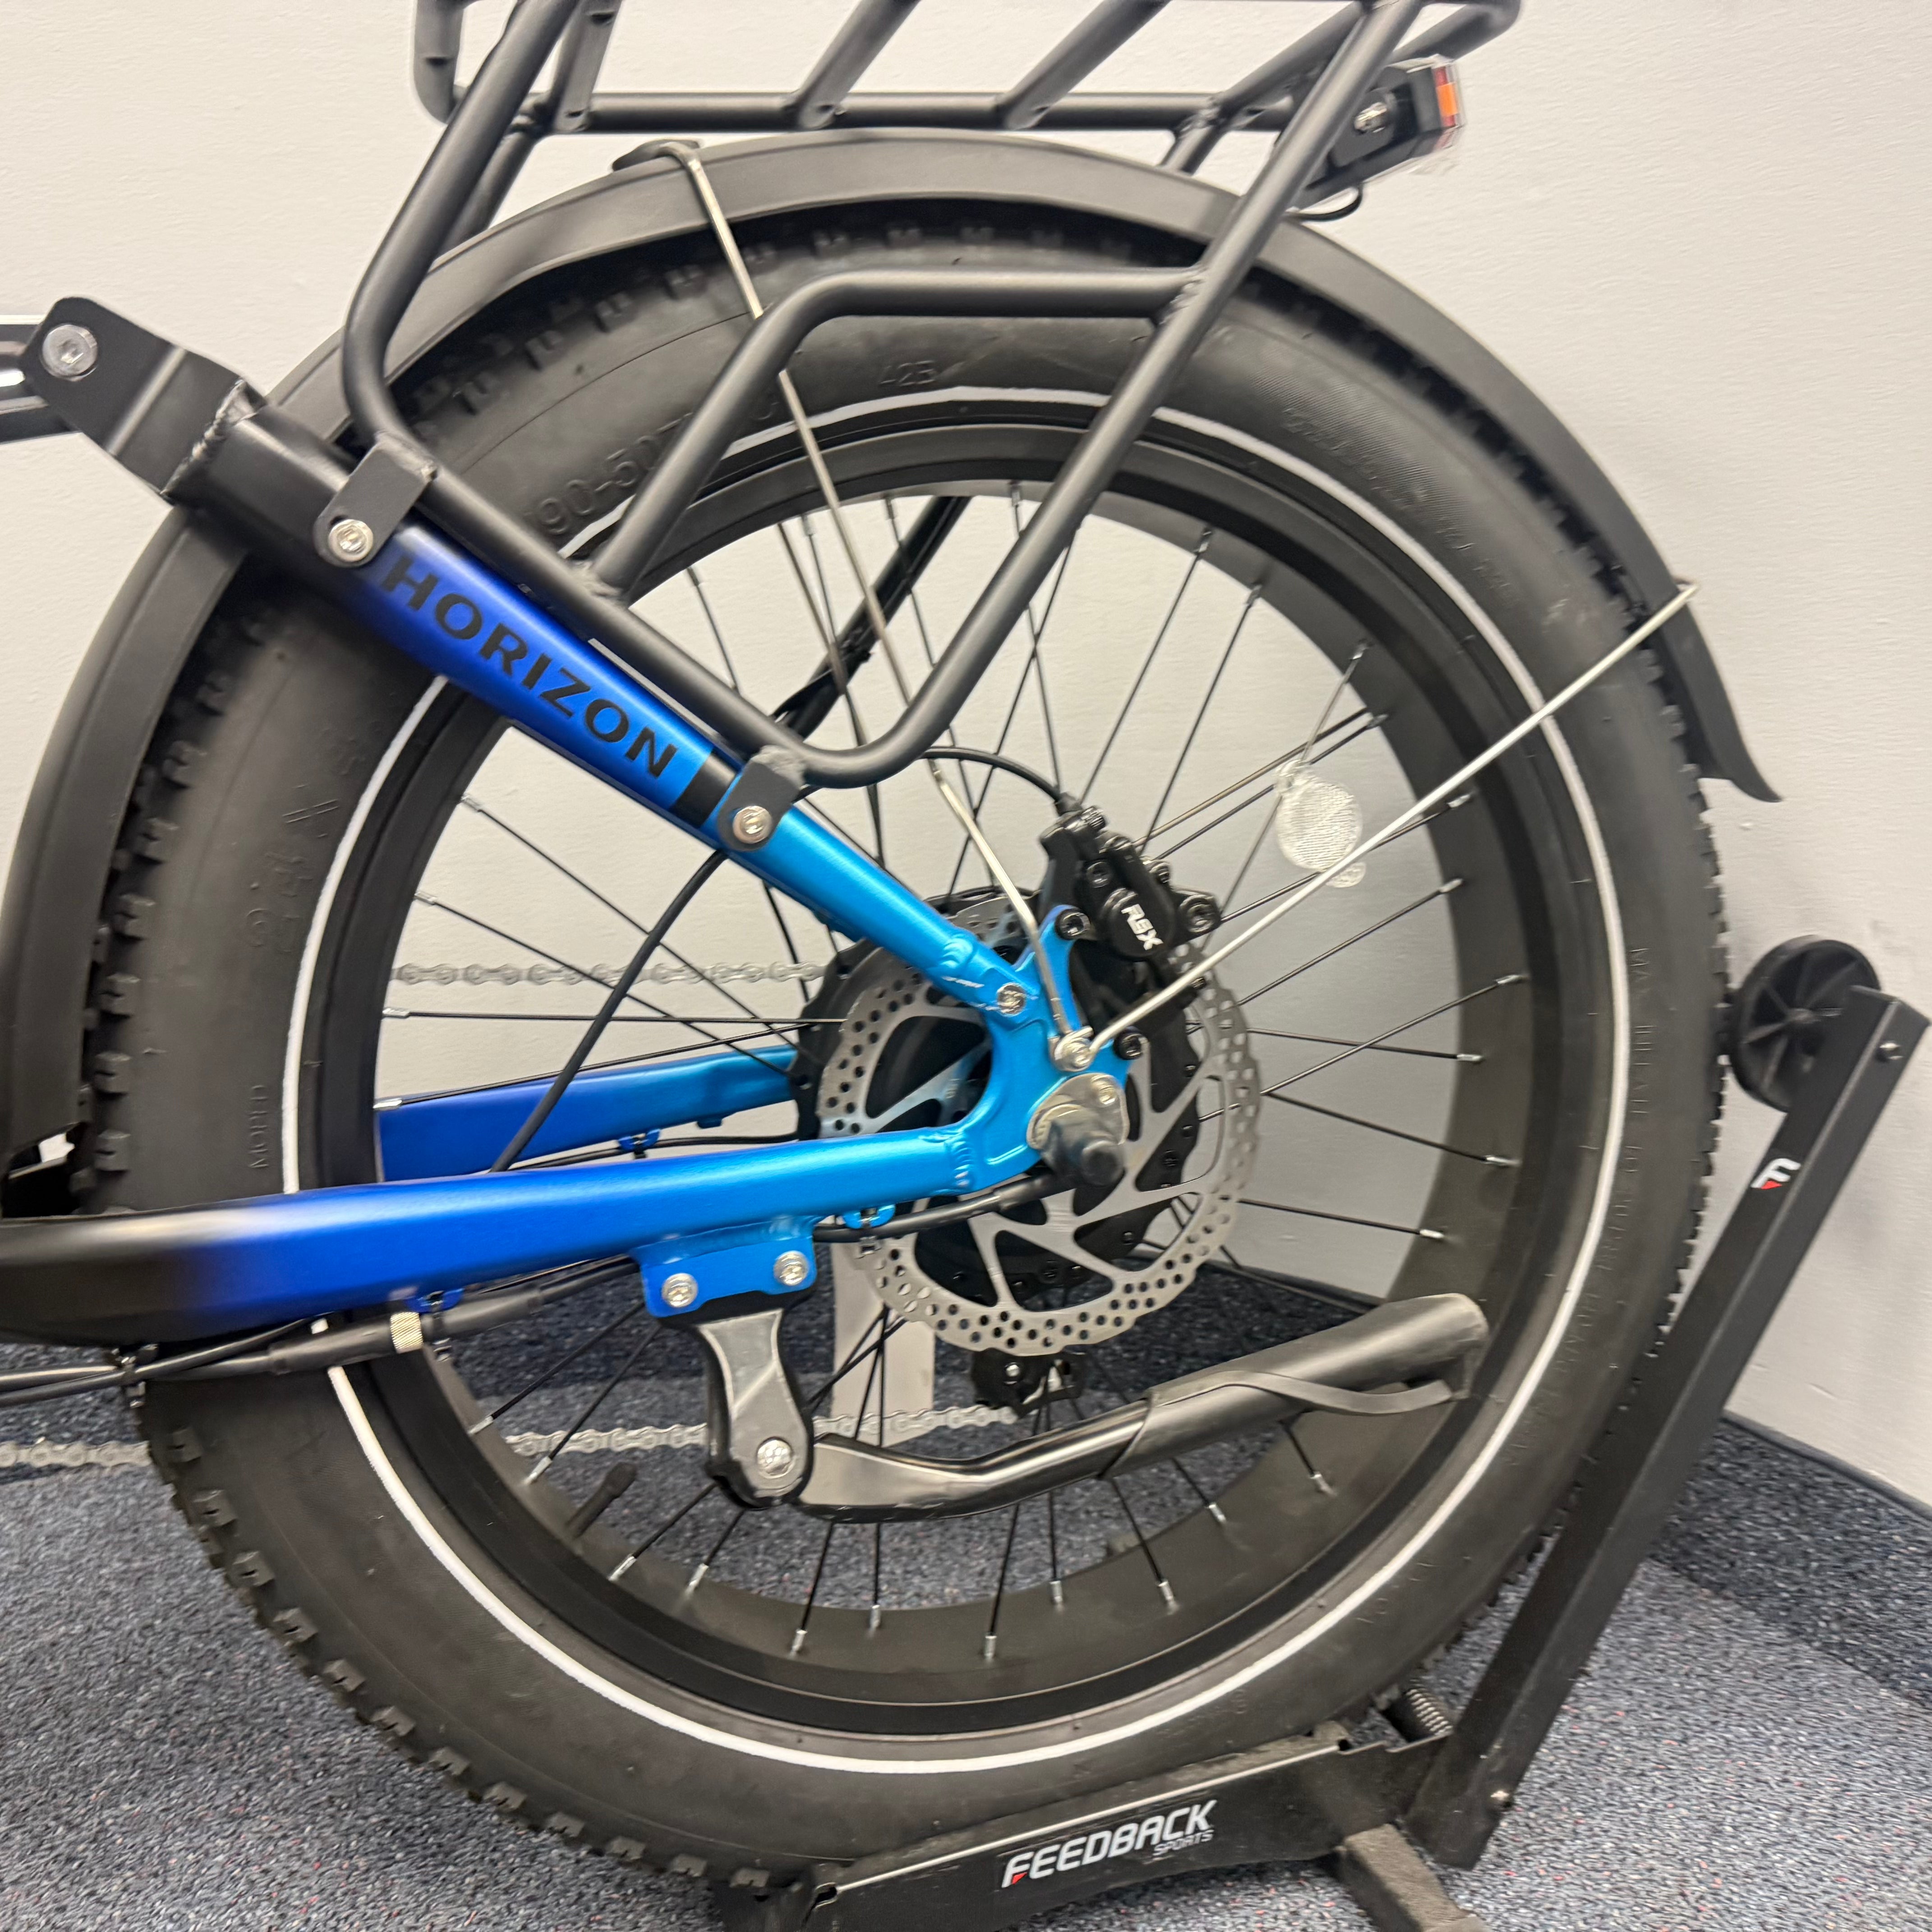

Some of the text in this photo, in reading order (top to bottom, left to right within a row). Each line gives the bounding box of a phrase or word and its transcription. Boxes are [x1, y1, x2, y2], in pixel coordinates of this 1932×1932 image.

[380, 555, 678, 779] HORIZON
[1121, 904, 1164, 950] RSX
[1001, 1799, 1217, 1888] FEEDBACK
[1152, 1830, 1214, 1856] SPORTS
